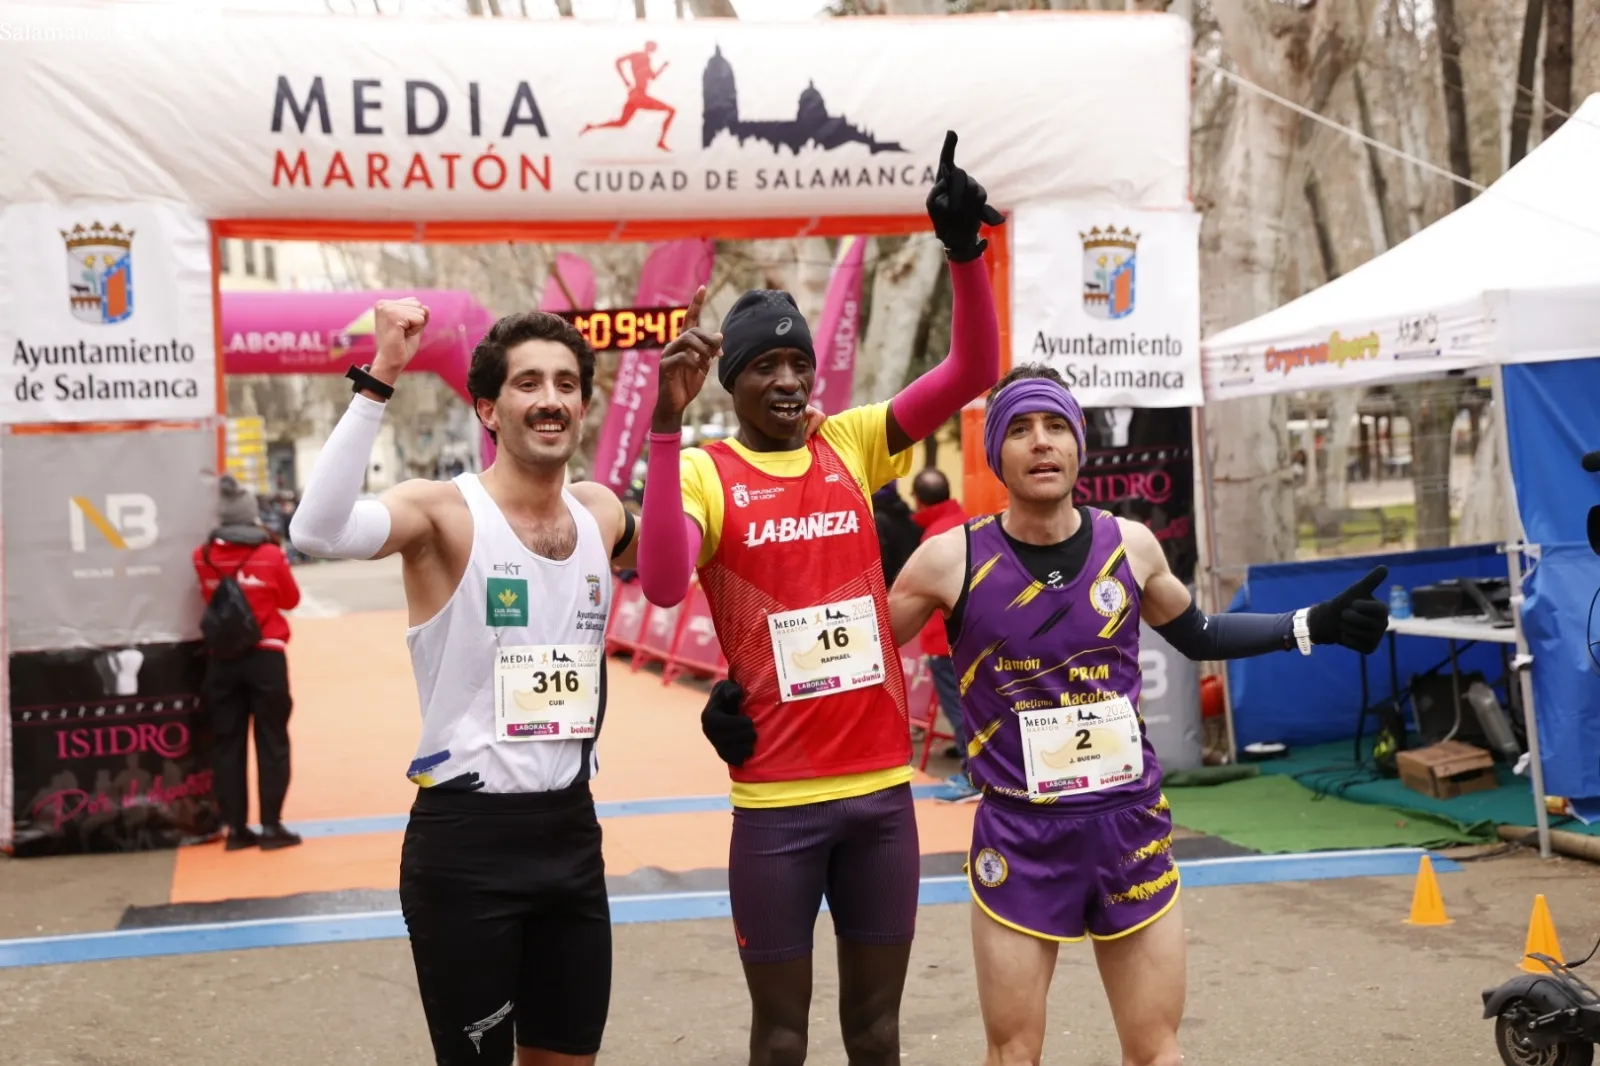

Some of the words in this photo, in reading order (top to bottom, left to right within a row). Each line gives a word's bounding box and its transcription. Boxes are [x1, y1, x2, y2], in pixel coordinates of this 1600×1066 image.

[271, 75, 549, 138] MEDIA
[272, 143, 552, 192] MARATÓN
[575, 170, 688, 192] CIUDAD
[705, 170, 738, 190] DE
[757, 165, 936, 190] SALAMANCA
[222, 330, 326, 354] ABORAL
[1032, 330, 1183, 359] Ayuntamiento
[13, 338, 195, 372] Ayuntamiento
[15, 375, 43, 401] de
[55, 373, 198, 400] Salamanca
[1065, 363, 1184, 389] Salamanca
[1074, 469, 1172, 504] SIDRO
[69, 493, 158, 553] NB
[775, 617, 807, 630] MEDIA
[817, 626, 849, 650] 16
[501, 654, 534, 664] MEDIA
[821, 653, 851, 664] RAPHAEL
[994, 656, 1041, 672] Jamón
[532, 670, 579, 694] 316
[1069, 664, 1110, 682] PRIM
[1025, 716, 1058, 727] MEDIA
[56, 721, 190, 760] ISIDRO
[1075, 729, 1092, 750] 2
[1076, 754, 1101, 762] BUENO
